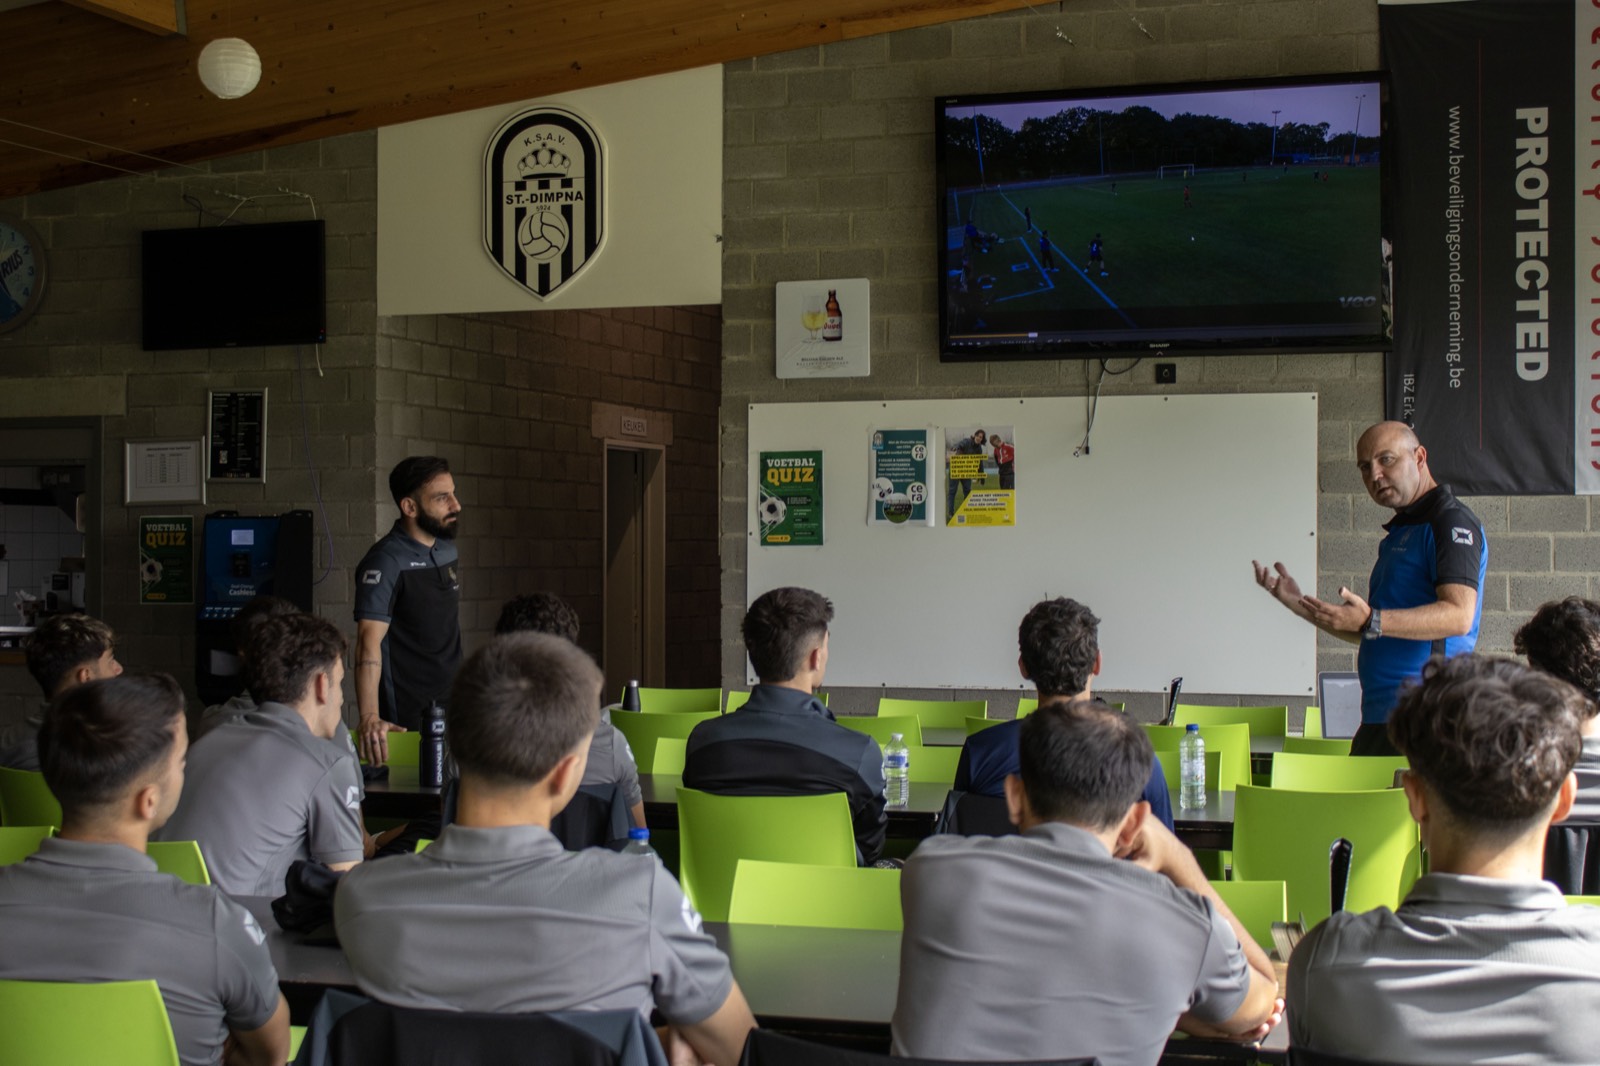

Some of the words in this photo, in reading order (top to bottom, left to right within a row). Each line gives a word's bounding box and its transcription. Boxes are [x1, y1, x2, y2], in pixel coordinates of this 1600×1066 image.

[524, 133, 565, 146] K.S.A.V.
[506, 191, 583, 204] ST.-DIMPNA
[1446, 106, 1464, 388] www.beveiligingsonderneming.be
[1515, 106, 1549, 382] PROTECTED
[1403, 374, 1415, 393] IBZ
[1403, 397, 1416, 419] Erk.
[767, 458, 816, 467] VOETBAL
[767, 467, 814, 486] QUIZ
[911, 485, 923, 493] ce
[146, 524, 187, 532] VOETBAL
[145, 532, 186, 548] QUIZ
